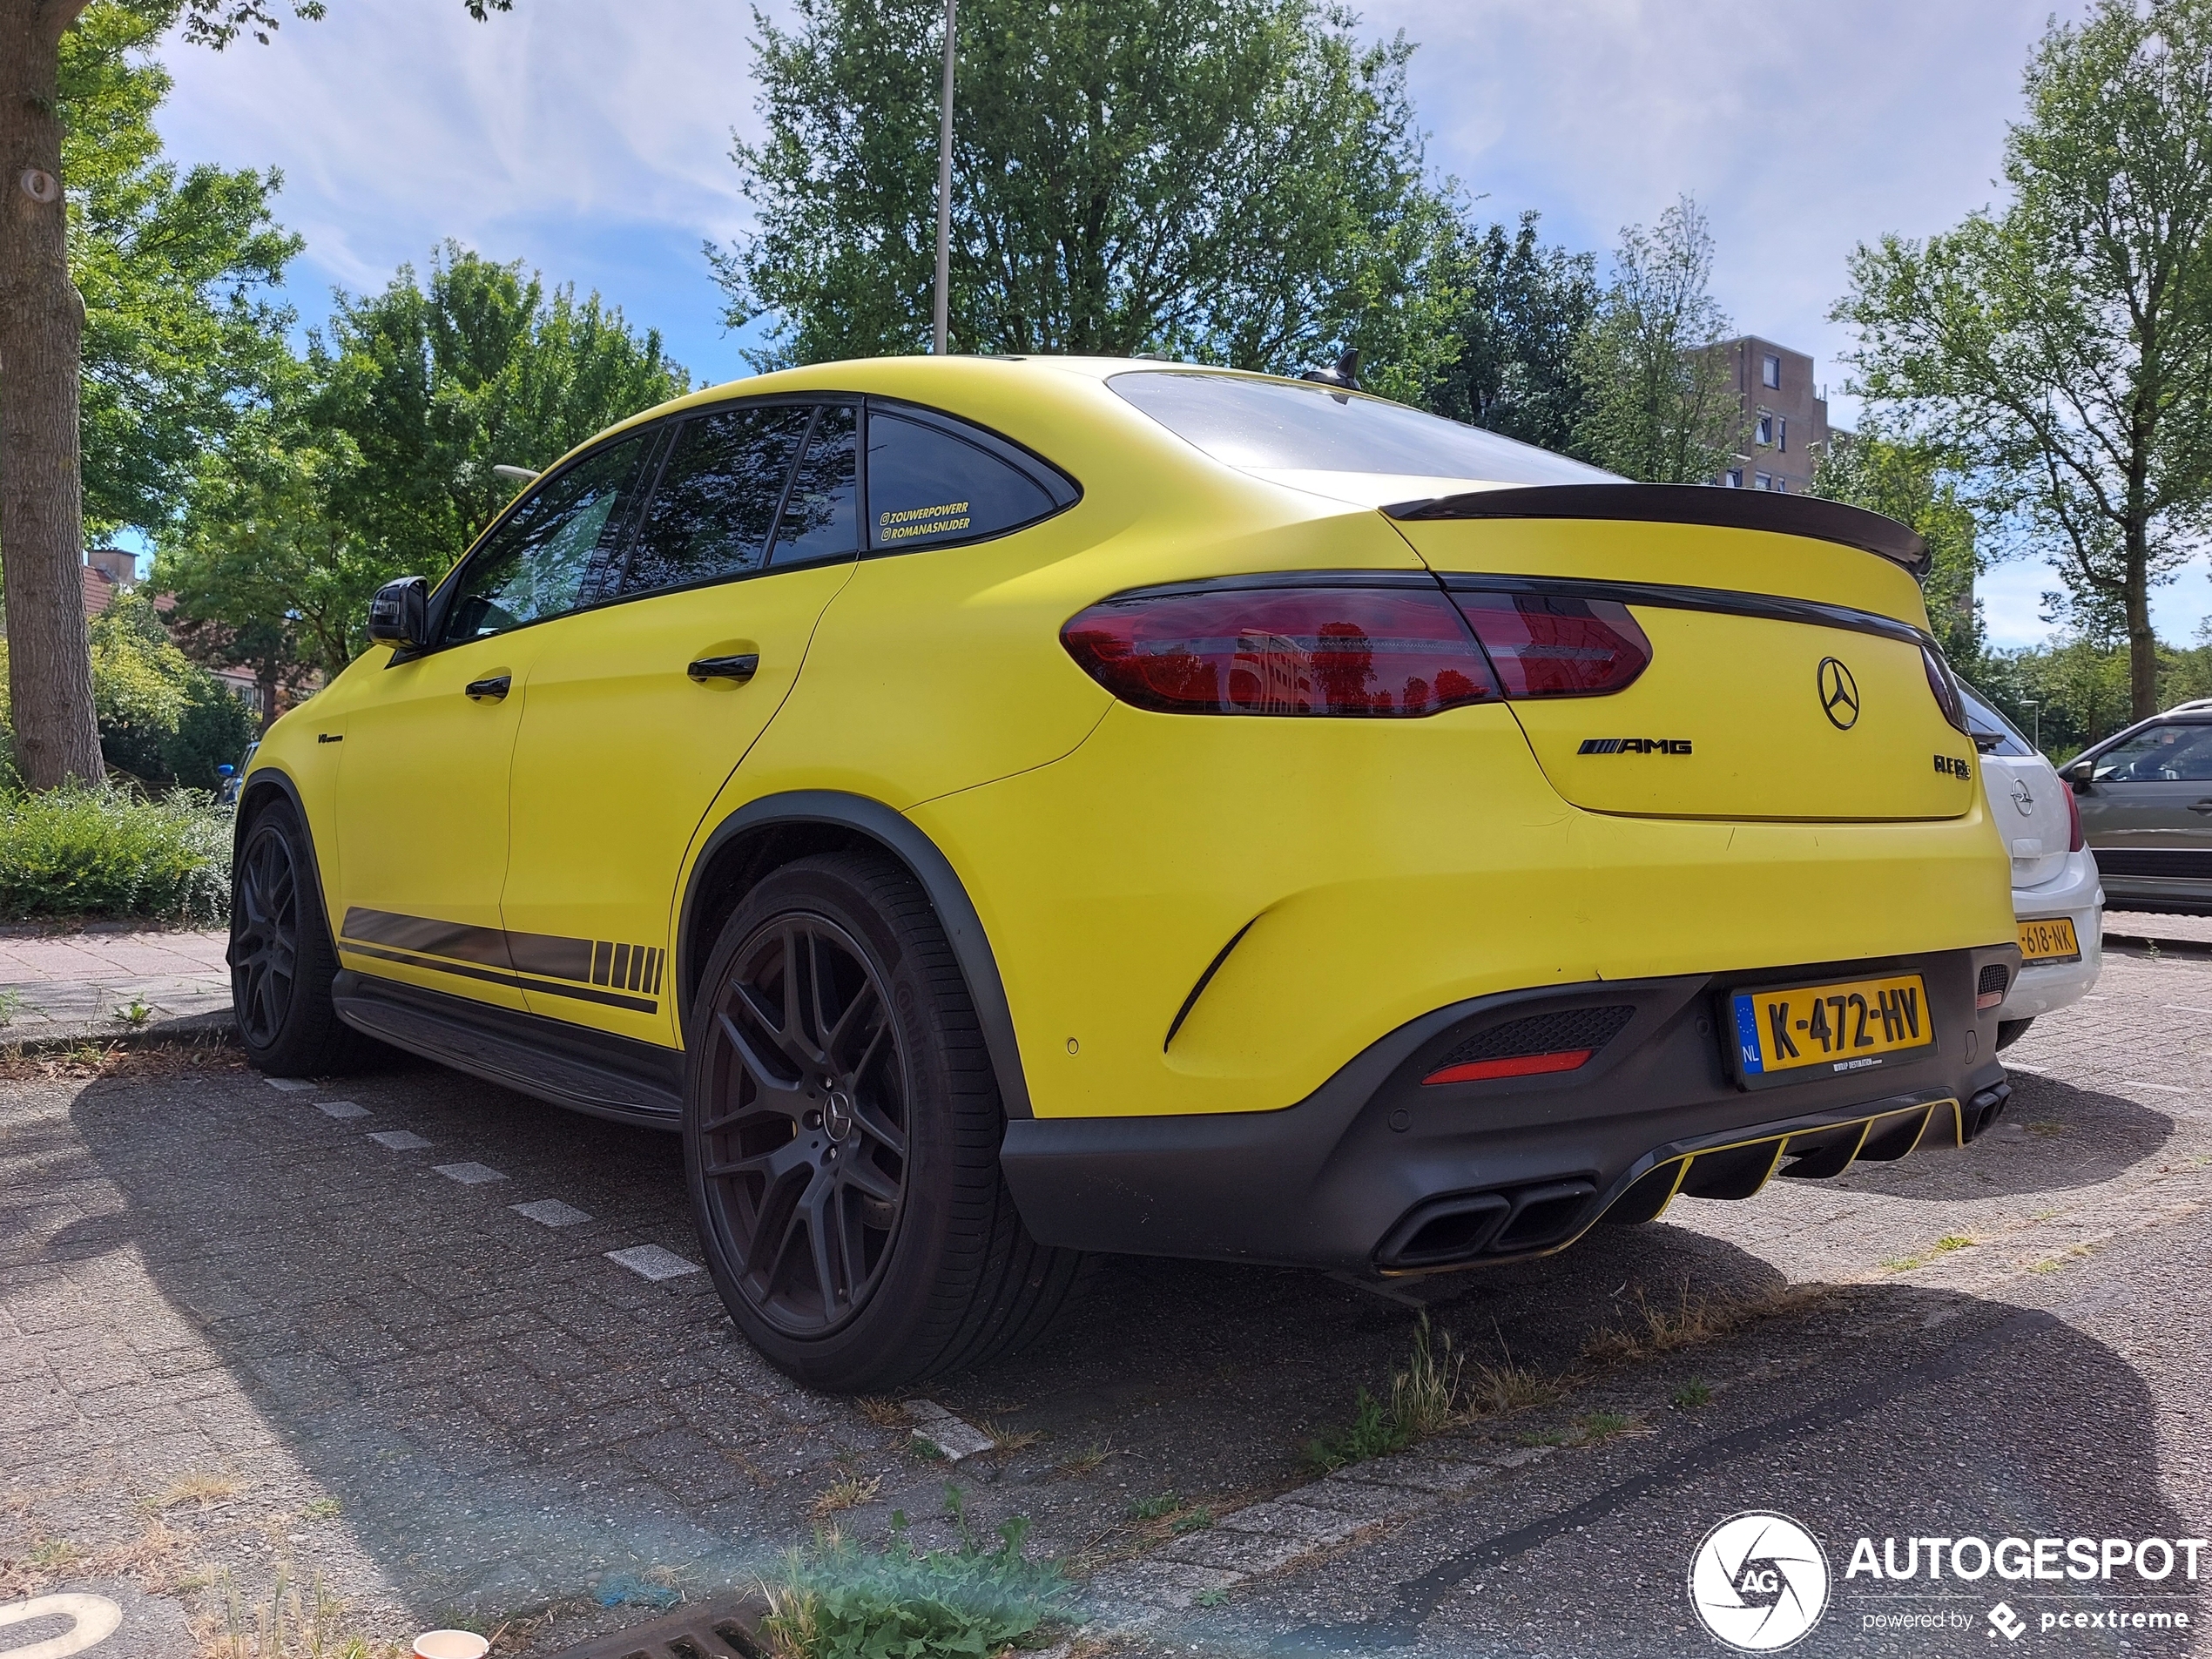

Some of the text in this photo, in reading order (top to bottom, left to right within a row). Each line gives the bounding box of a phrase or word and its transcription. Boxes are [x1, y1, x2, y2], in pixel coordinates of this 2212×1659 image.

[889, 502, 968, 524] ZOUWERPOWERR
[891, 517, 970, 539] ROMANASNIJDER
[1616, 738, 1692, 755] AMG
[2017, 925, 2073, 954] -618-NK
[1768, 987, 1919, 1061] K-472-HV
[1743, 1044, 1759, 1063] NL
